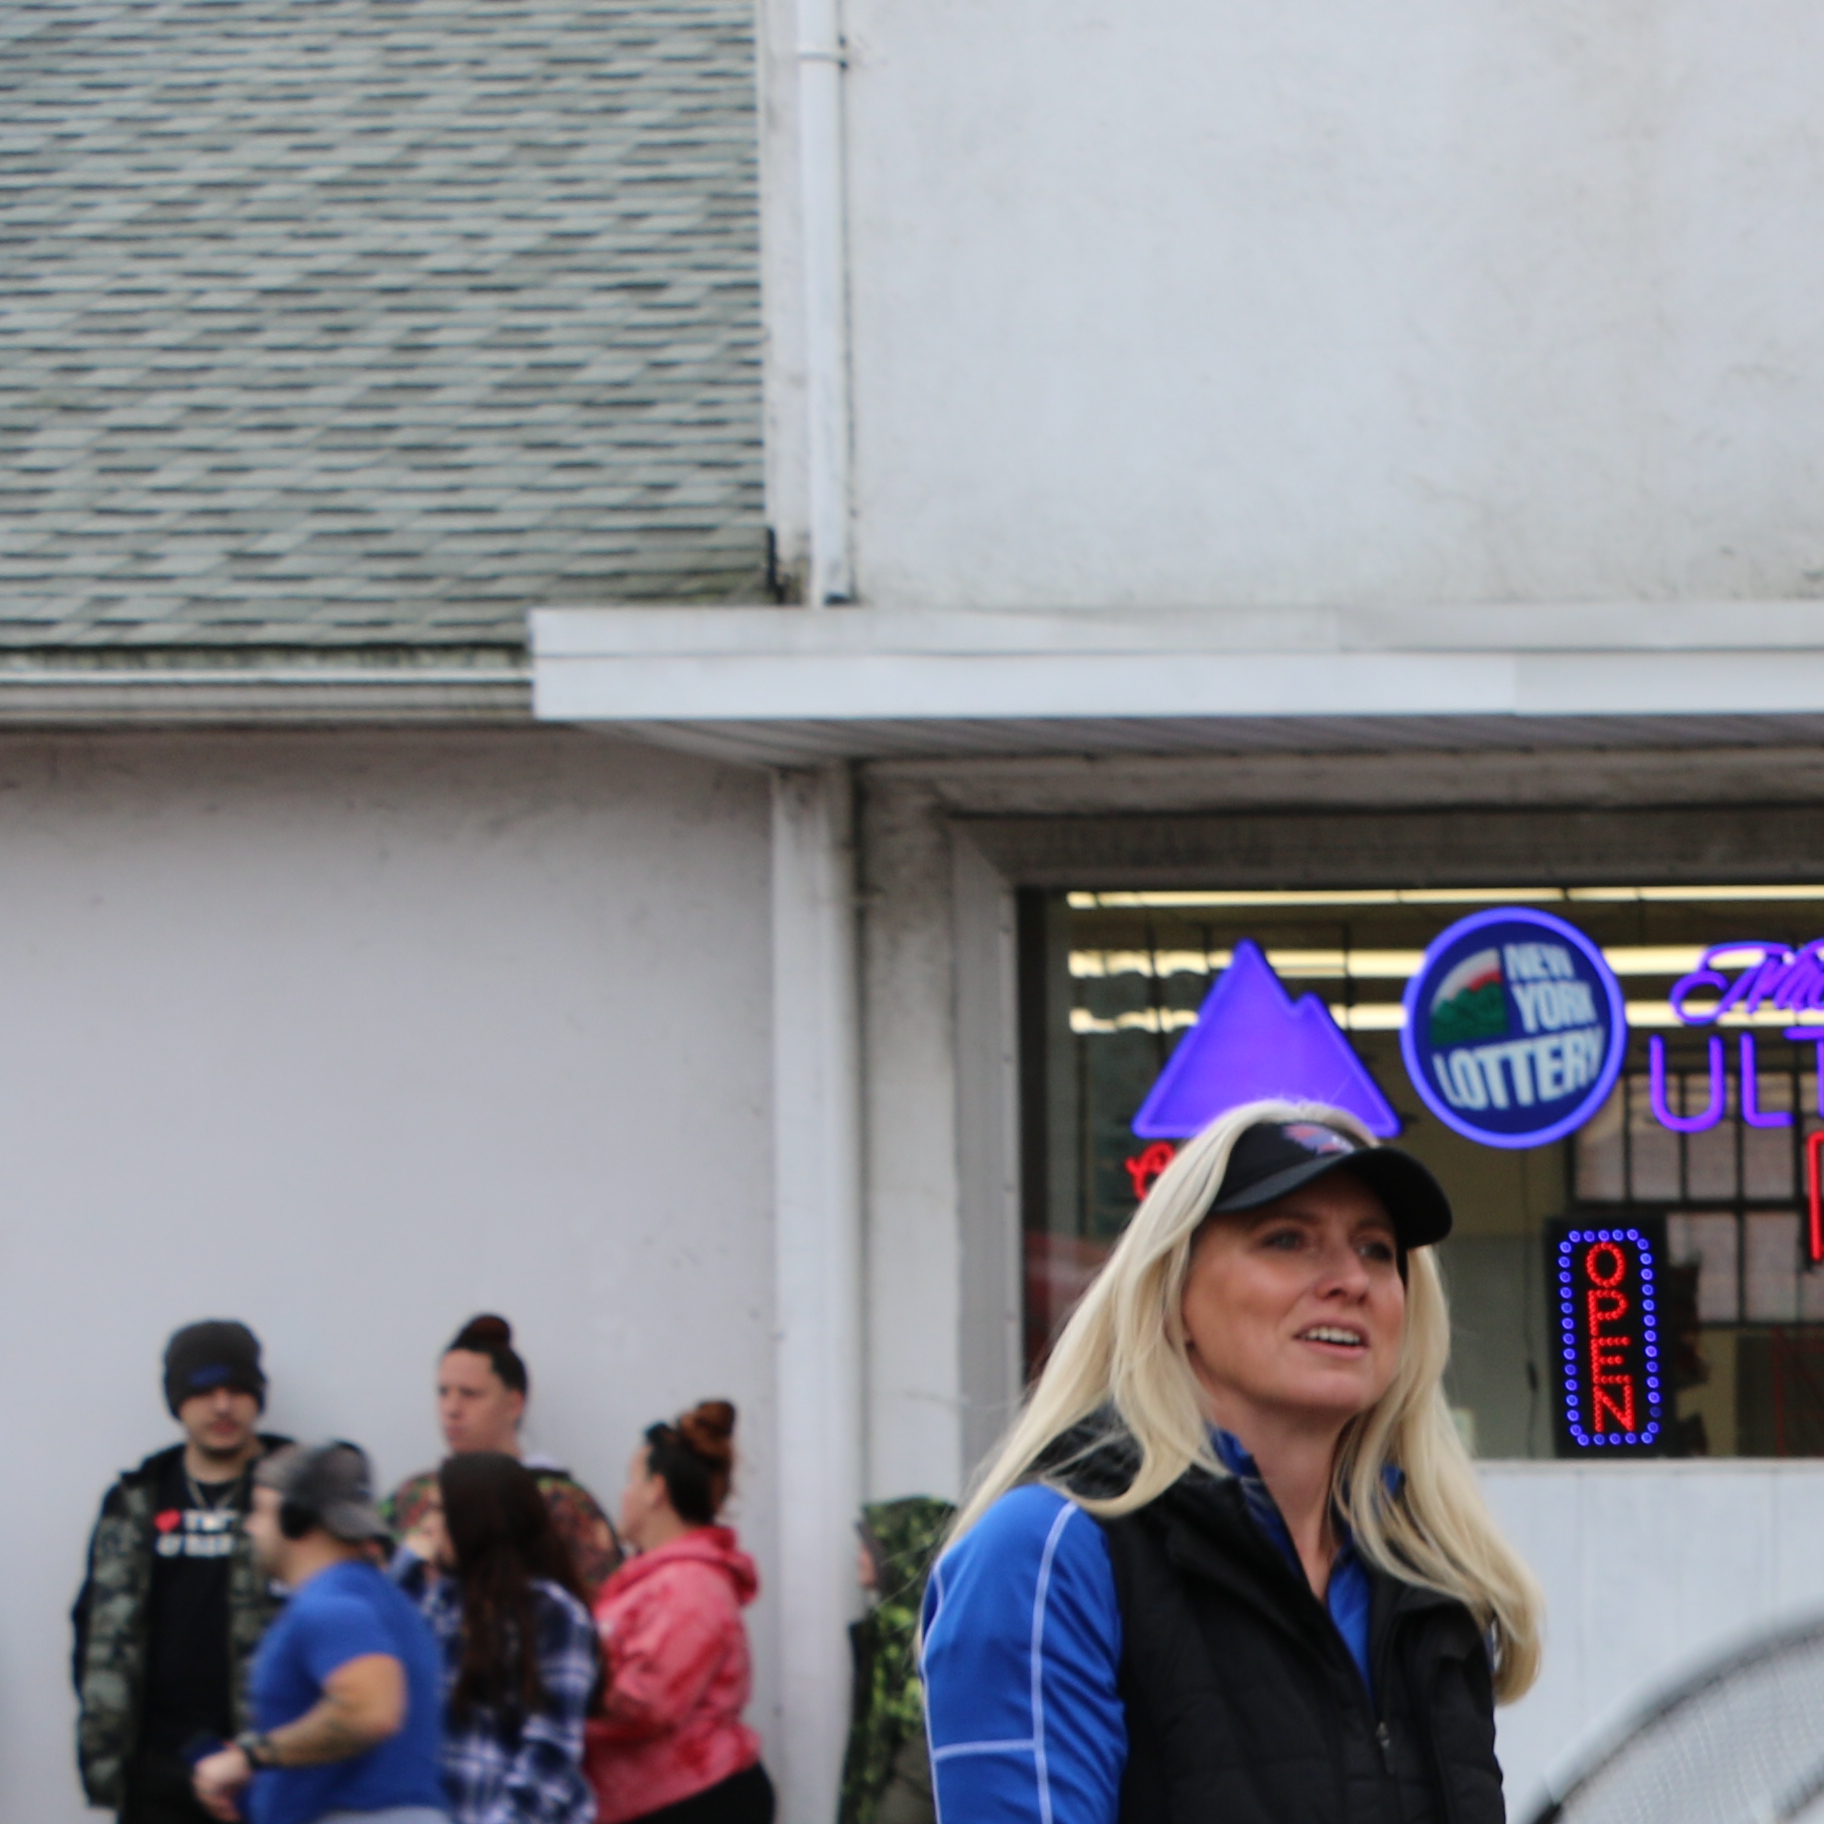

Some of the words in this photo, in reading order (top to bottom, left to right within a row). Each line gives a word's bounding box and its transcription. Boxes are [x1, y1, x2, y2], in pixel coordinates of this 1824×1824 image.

[1503, 942, 1575, 981] NEW
[1511, 980, 1598, 1034] YORK
[1431, 1026, 1605, 1111] LOTTERY
[1585, 1241, 1636, 1433] OPEN
